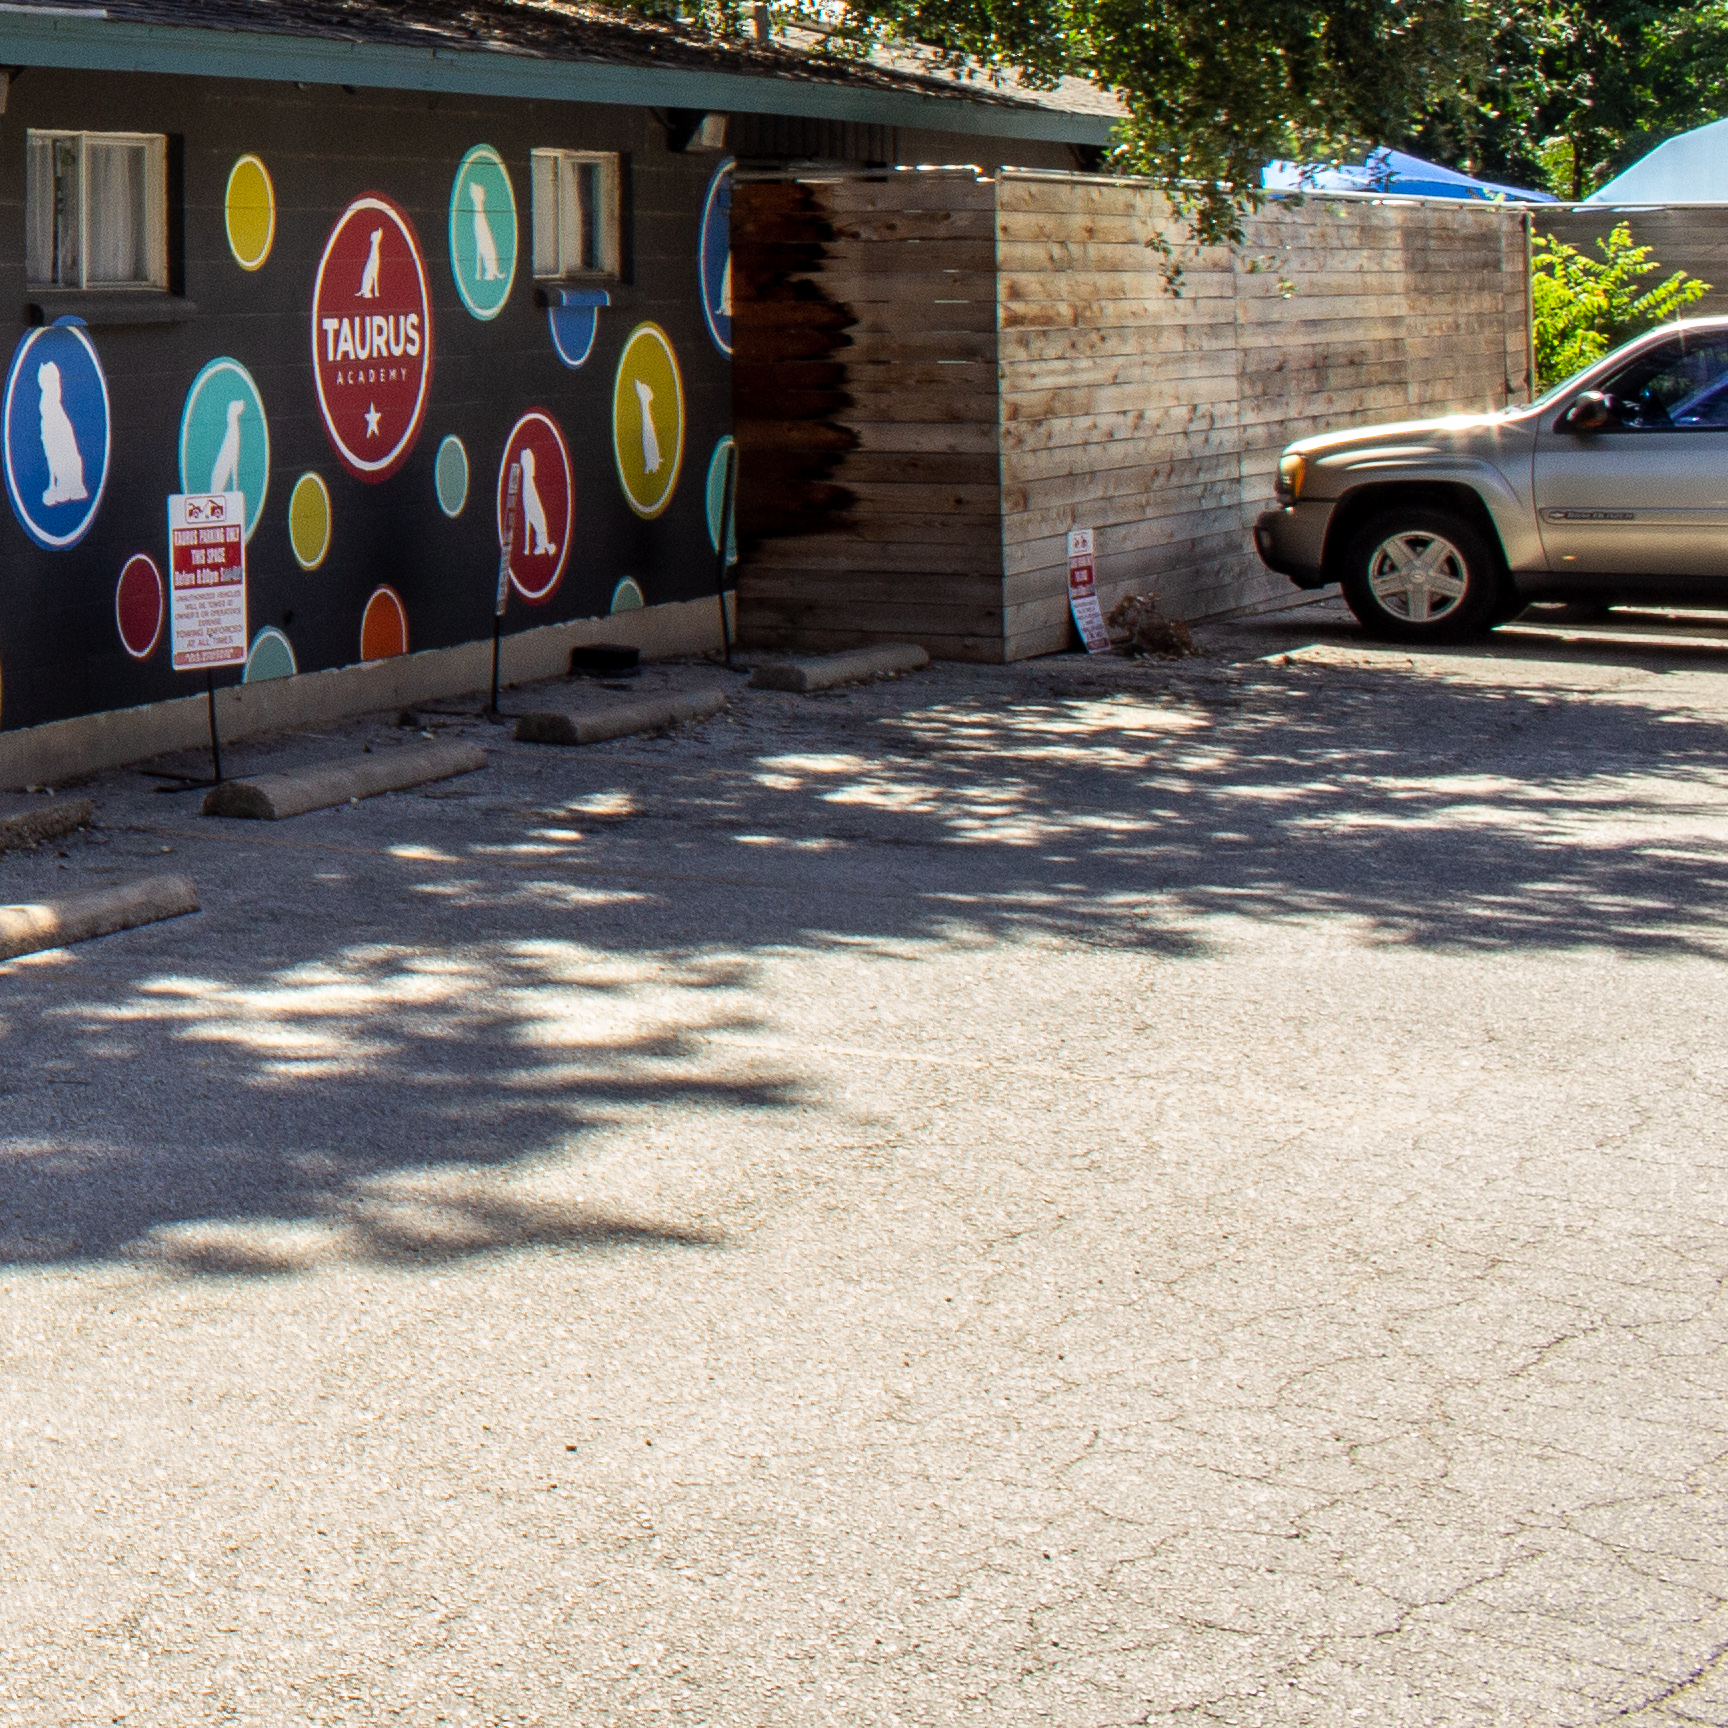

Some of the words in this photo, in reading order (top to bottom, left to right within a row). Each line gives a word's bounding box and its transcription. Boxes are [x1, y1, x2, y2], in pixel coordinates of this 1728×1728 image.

[322, 313, 420, 362] TAURUS
[336, 367, 406, 386] ACADEMY
[174, 530, 198, 546] TAURUS
[199, 527, 225, 544] PARKING
[225, 526, 240, 542] ONLY
[191, 548, 206, 564] THIS
[206, 547, 226, 564] SPACE
